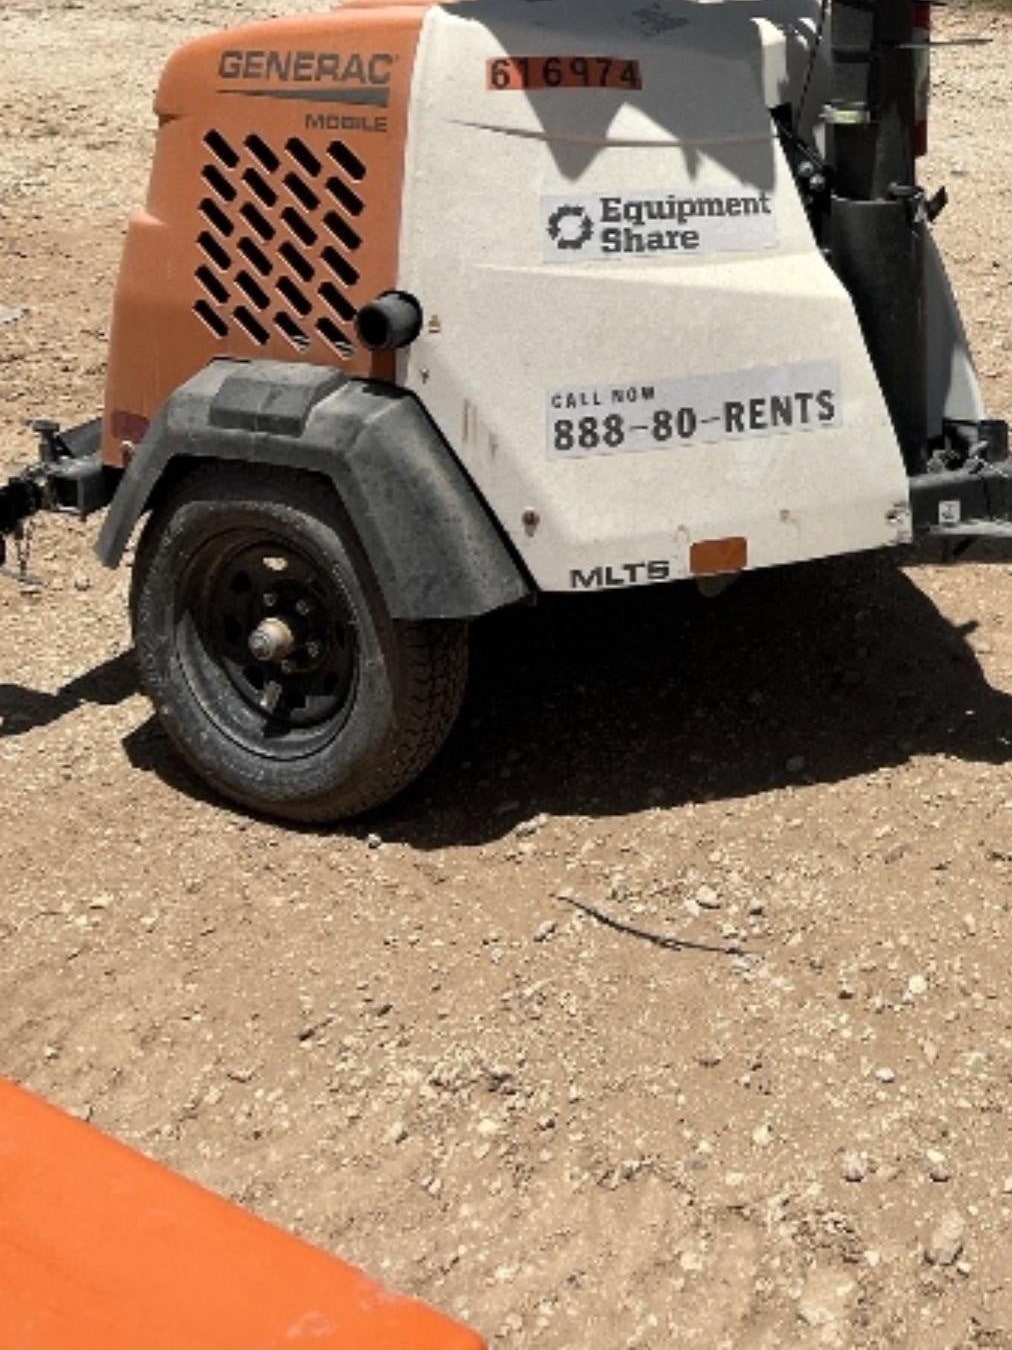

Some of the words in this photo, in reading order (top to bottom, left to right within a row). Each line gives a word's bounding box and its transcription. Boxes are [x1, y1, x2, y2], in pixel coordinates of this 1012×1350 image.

[218, 50, 394, 84] GENERAC
[491, 57, 641, 90] 616974
[305, 114, 387, 131] MOBILE
[600, 190, 771, 225] Equipment
[601, 228, 700, 253] Share
[551, 391, 601, 408] CALL
[611, 386, 655, 403] NOW
[553, 389, 836, 450] 888-80-RENTS
[570, 560, 669, 588] MLTS
